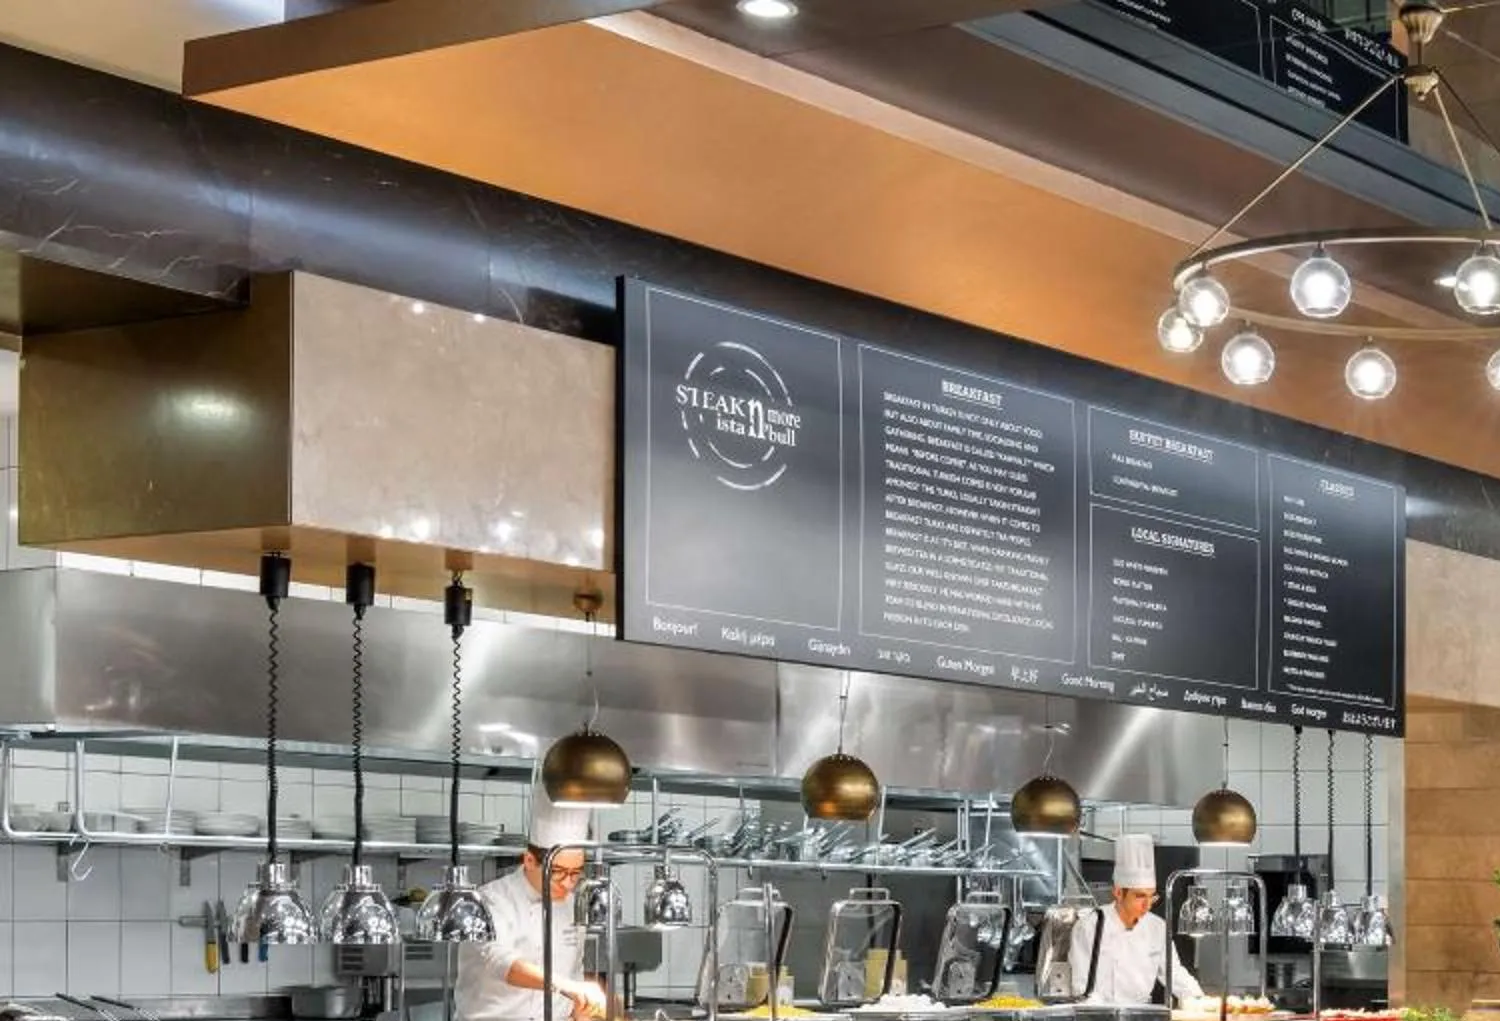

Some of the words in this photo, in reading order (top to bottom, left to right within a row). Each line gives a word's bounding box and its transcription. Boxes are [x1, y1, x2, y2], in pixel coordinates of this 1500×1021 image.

[676, 383, 745, 417] STEAK
[767, 408, 800, 428] more
[942, 380, 1002, 407] BREAKFAST
[717, 412, 745, 435] ista
[1165, 438, 1213, 461] BREAKFAST
[1131, 526, 1160, 543] LOCAL
[1161, 533, 1214, 554] SIGNATURES
[1060, 673, 1082, 686] Good
